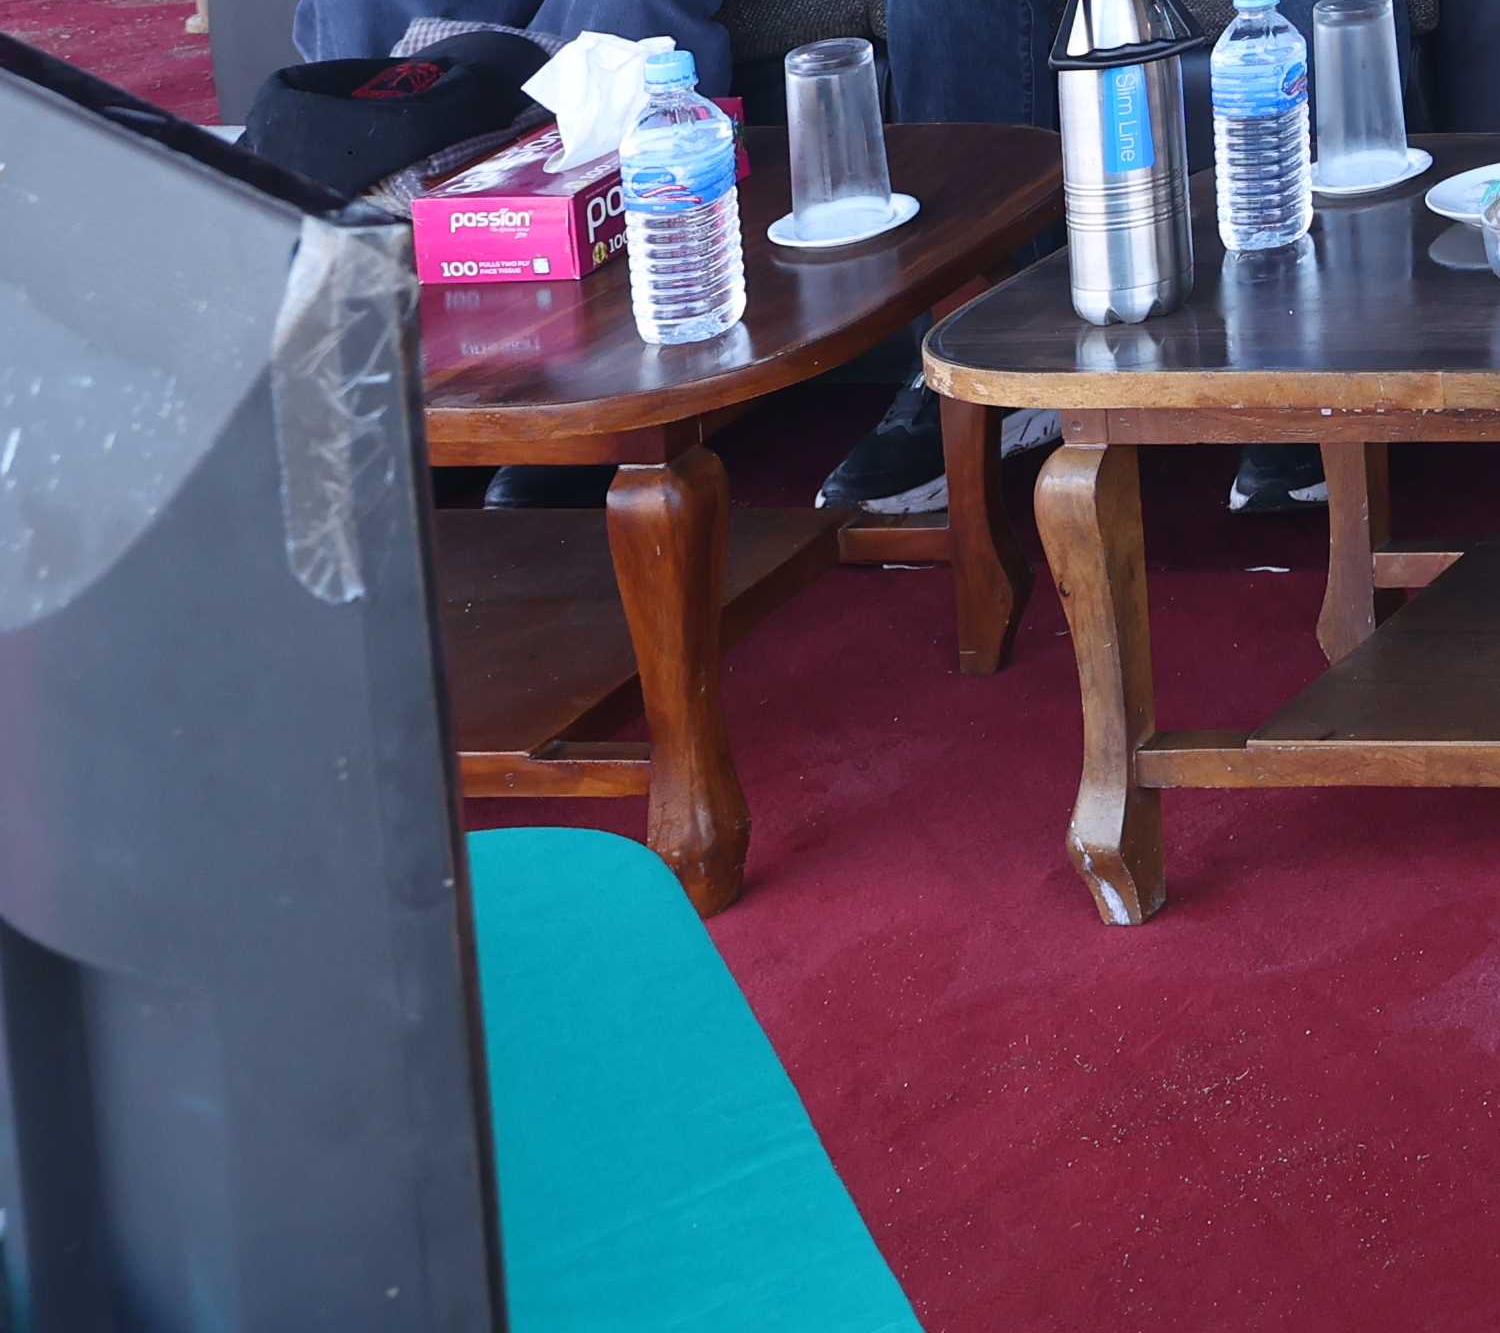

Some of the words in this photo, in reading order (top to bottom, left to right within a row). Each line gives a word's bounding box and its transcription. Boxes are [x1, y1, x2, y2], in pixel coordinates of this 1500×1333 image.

[1115, 73, 1136, 115] Slim
[1118, 120, 1139, 162] Line
[450, 207, 531, 233] passion
[440, 261, 478, 277] 100
